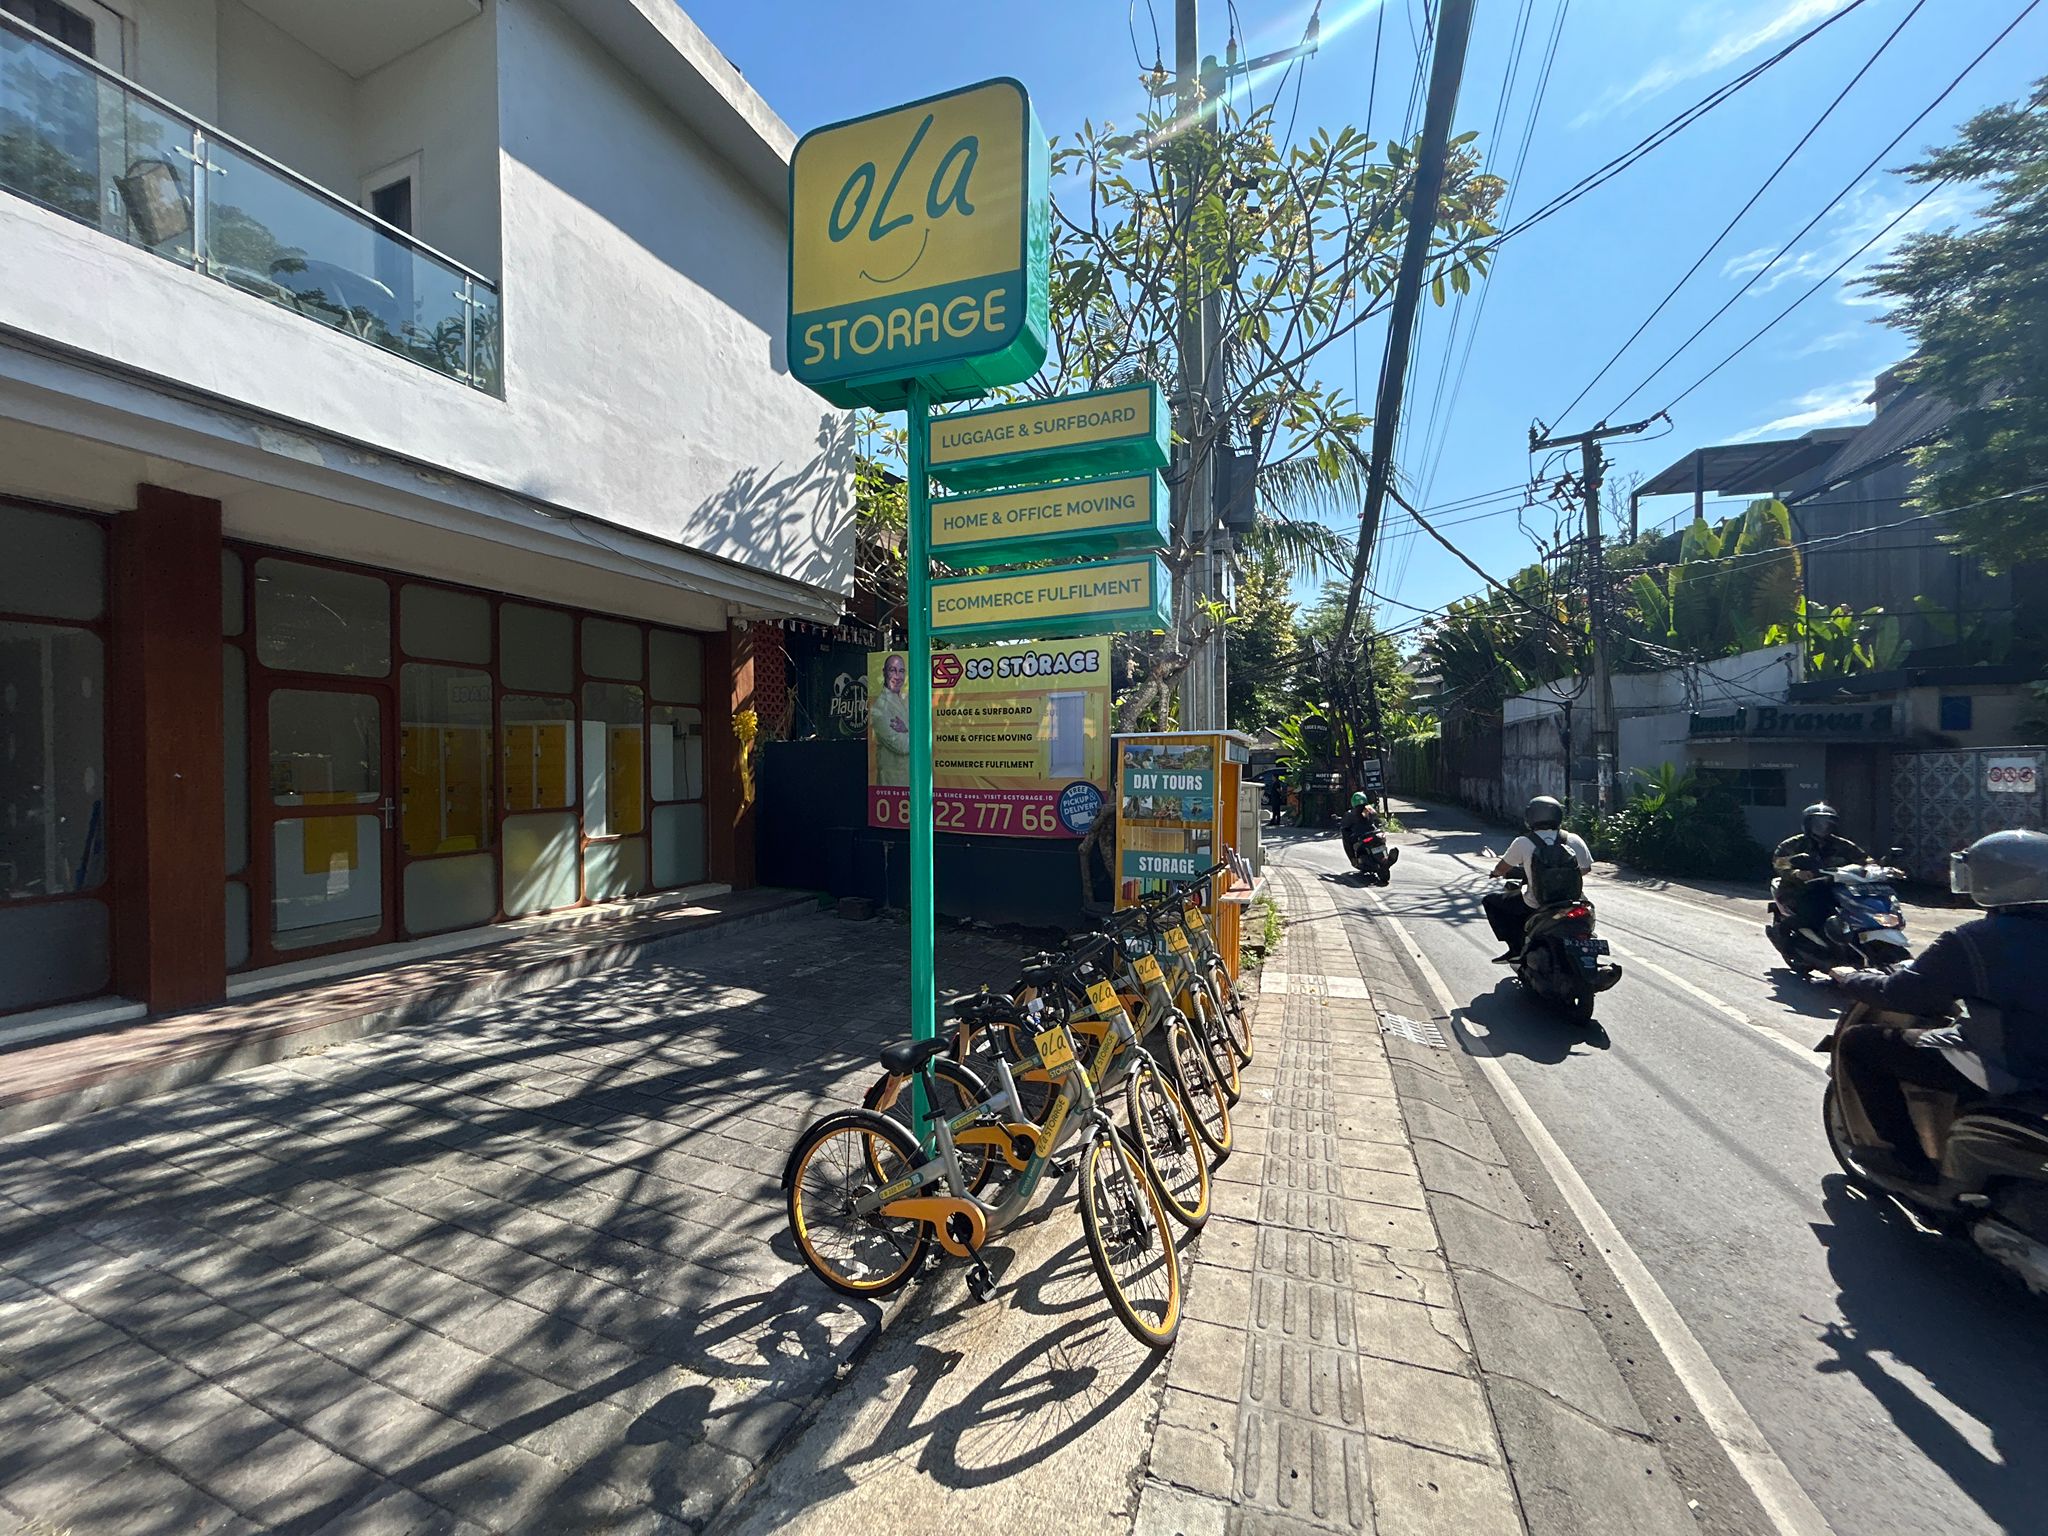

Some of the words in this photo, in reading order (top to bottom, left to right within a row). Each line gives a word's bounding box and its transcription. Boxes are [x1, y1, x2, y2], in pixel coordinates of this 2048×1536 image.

[803, 288, 1006, 366] STORAGE
[942, 423, 1014, 448] LUGGAGE
[1018, 423, 1030, 436] &
[1033, 407, 1136, 435] SURFBOARD
[943, 513, 989, 530] HOME
[991, 512, 1003, 524] &
[1006, 504, 1062, 523] OFFICE
[1066, 494, 1135, 516] MOVING
[937, 590, 1034, 612] ECOMMERCE
[1038, 578, 1142, 602] FULFILMENT
[965, 658, 993, 680] SC
[997, 650, 1099, 679] STORAGE
[936, 708, 973, 717] LUGGAGE
[974, 708, 981, 716] &
[982, 706, 1032, 716] SURFBOARD
[936, 734, 959, 742] HOME
[960, 734, 967, 742] &
[968, 734, 996, 742] OFFICE
[997, 733, 1032, 742] MOVING
[935, 760, 984, 769] ECOMMERCE
[985, 760, 1034, 769] FULFILMENT
[1069, 786, 1086, 795] FREE
[1133, 774, 1158, 790] DAY
[1162, 775, 1203, 790] TOURS
[1063, 795, 1089, 807] PICKUP
[1064, 801, 1098, 815] DELIVERY
[876, 799, 890, 822] 0
[974, 803, 1013, 830] 777
[1022, 804, 1057, 832] 66
[1138, 857, 1195, 874] STORAGE
[1046, 1099, 1066, 1138] STORAGE
